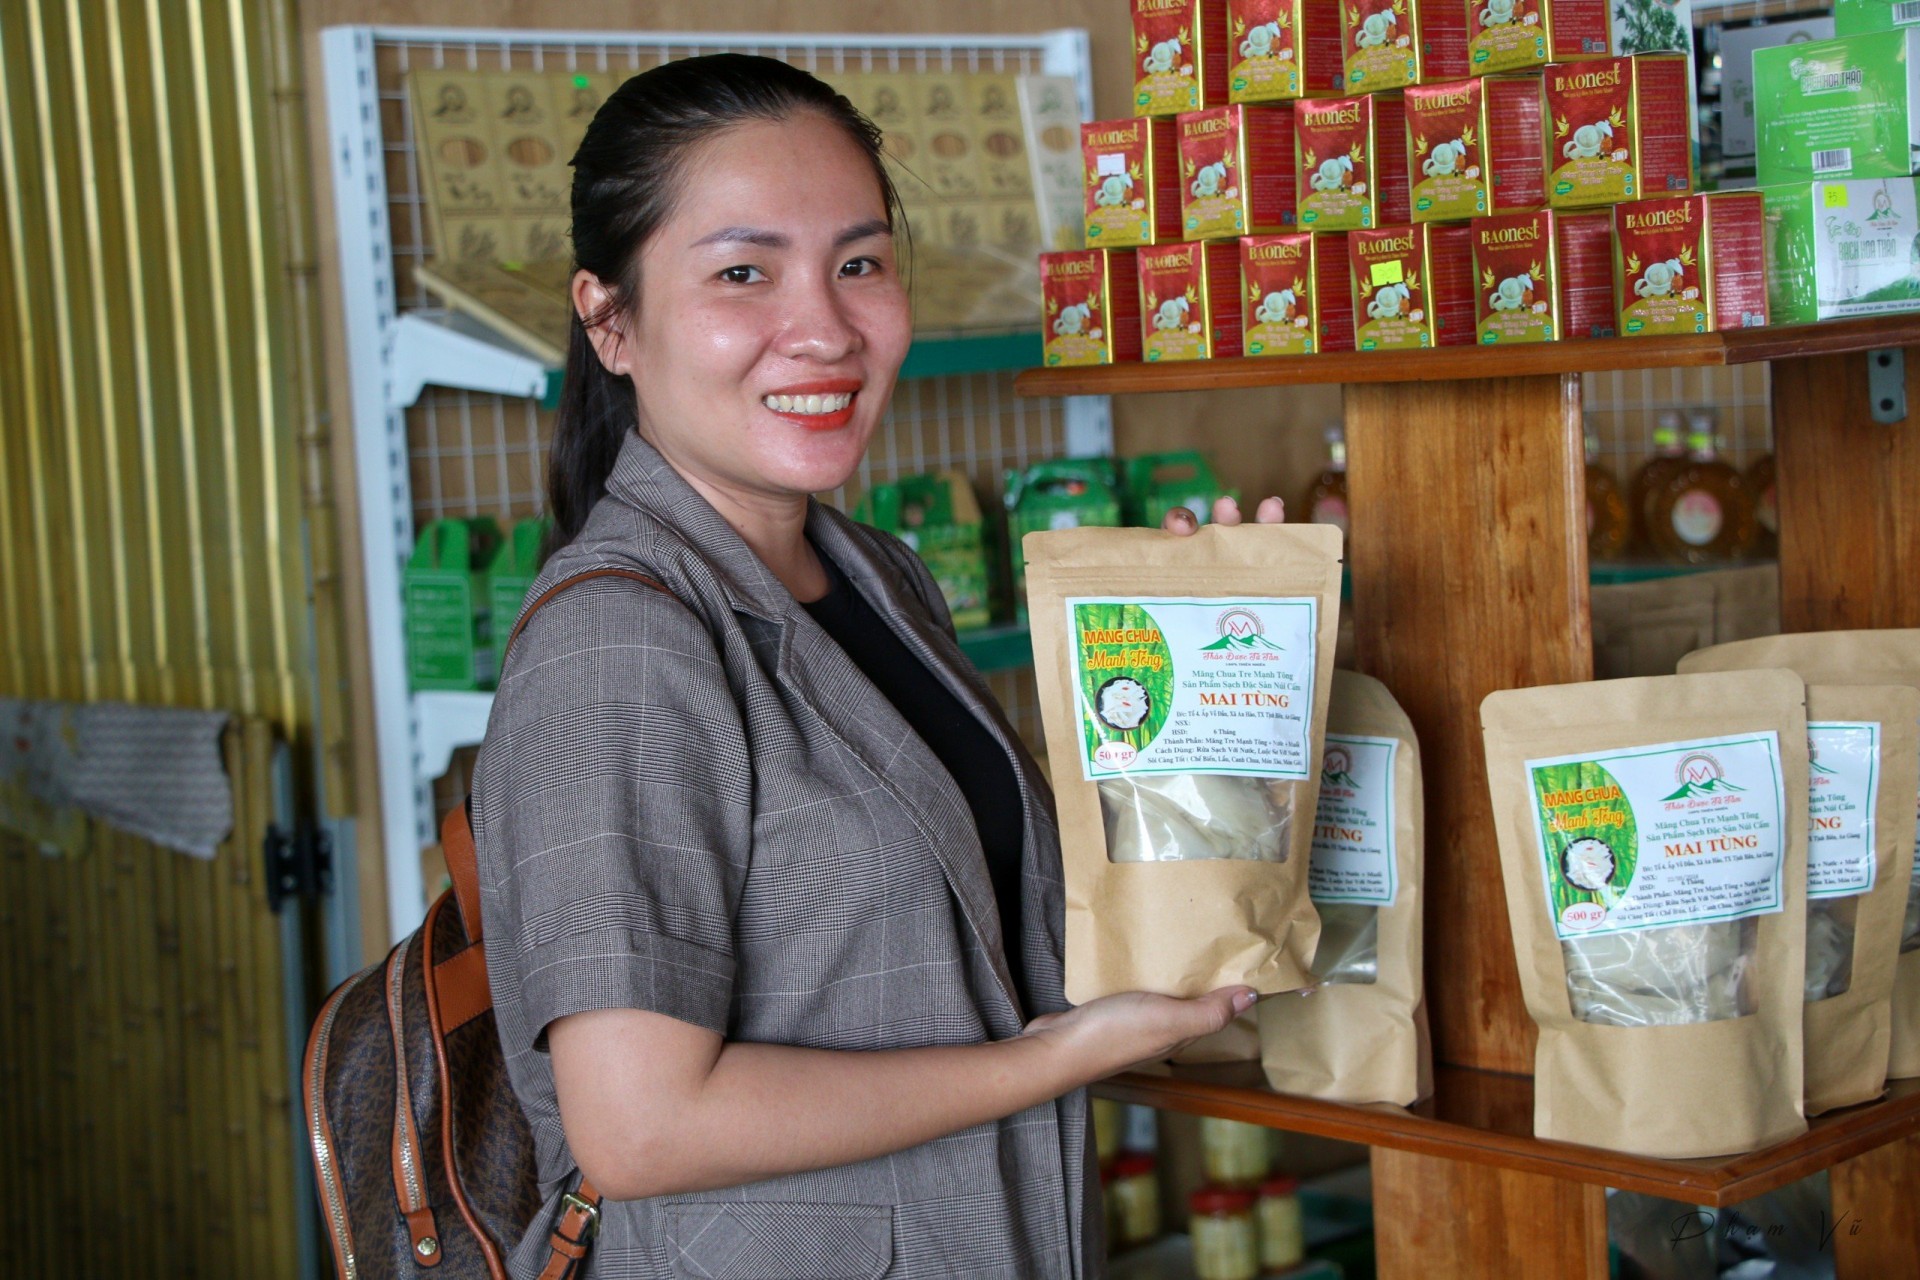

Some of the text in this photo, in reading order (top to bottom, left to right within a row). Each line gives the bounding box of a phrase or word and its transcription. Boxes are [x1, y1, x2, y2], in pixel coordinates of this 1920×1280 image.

[1126, 629, 1161, 644] CHUA
[1254, 670, 1275, 678] Mạnh
[1222, 681, 1240, 689] Sạch
[1200, 690, 1289, 708] MAI TÙNG
[1121, 750, 1134, 762] gr
[1585, 784, 1621, 802] CHUA
[1680, 818, 1700, 827] Chua
[1702, 816, 1716, 824] Tre
[1322, 824, 1363, 842] TÙNG
[1687, 828, 1705, 838] Sạch
[1664, 834, 1758, 858] MAI TÙNG
[1567, 910, 1602, 922] 500 gr
